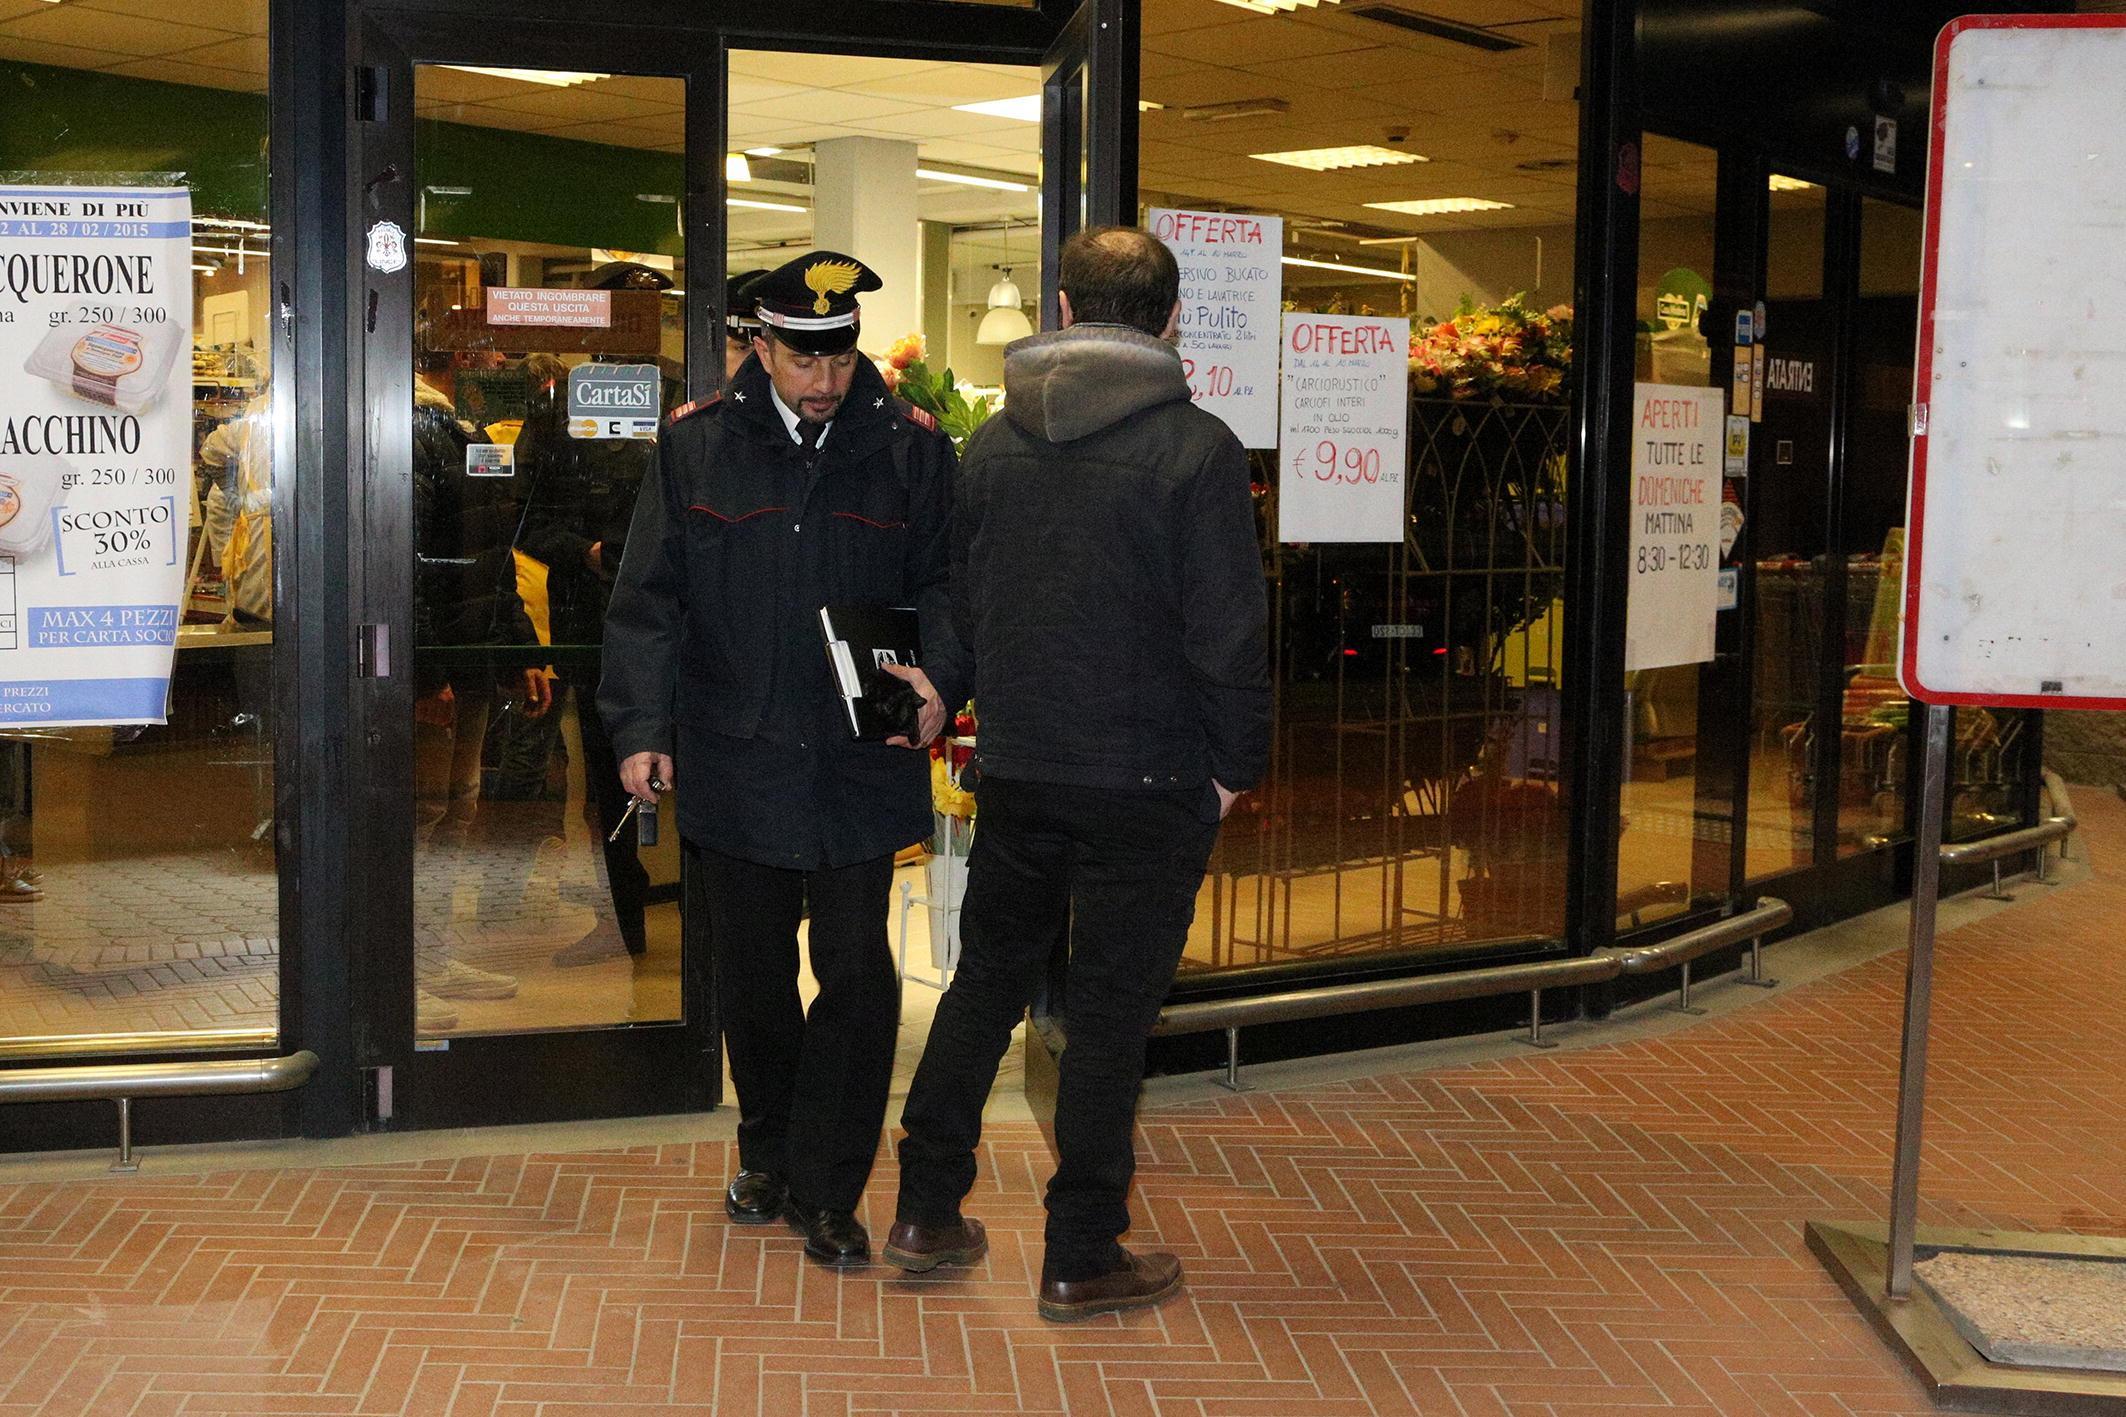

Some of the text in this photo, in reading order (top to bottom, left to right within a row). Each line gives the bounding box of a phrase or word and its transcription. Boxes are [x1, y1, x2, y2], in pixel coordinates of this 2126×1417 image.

[82, 203, 104, 217] DI
[116, 200, 149, 218] PIÙ
[18, 223, 43, 236] AL
[1156, 213, 1263, 244] OFFERTA
[1179, 267, 1269, 283] ERSIVO BUCATO
[492, 290, 607, 302] VIETATO INGOMBRARE
[1178, 288, 1256, 302] NO E LAVATRICE
[0, 309, 15, 323] a
[48, 310, 72, 328] gr.
[79, 306, 113, 324] 250
[133, 306, 167, 324] 300
[508, 303, 590, 313] QUESTA USCITA
[1177, 306, 1248, 329] iù Pulito
[492, 314, 606, 324] ANCHE TEMPORANEAMENTE
[1235, 330, 1243, 340] 2
[1292, 323, 1395, 355] OFFERTA
[1294, 396, 1366, 409] CARCIOFI INTERI
[1313, 414, 1323, 422] IN
[1641, 400, 1699, 429] APERTI
[0, 415, 141, 456] ACCHINO
[1646, 441, 1685, 465] TUTTE
[1690, 443, 1704, 465] LE
[1293, 448, 1307, 478] €
[1315, 441, 1380, 485] 9,90
[61, 473, 84, 490] gr.
[91, 469, 126, 485] 250
[144, 468, 175, 485] 300
[1638, 476, 1704, 506] DOMENICHE
[62, 506, 169, 533] SCONTO
[1645, 512, 1693, 534] MATTINA
[94, 529, 151, 555] 30%
[91, 556, 150, 570] ALLA CASSA
[42, 609, 174, 628] MAX 4 PEZZI
[39, 629, 175, 645] PER CARTA SOCIO
[4, 687, 49, 697] PREZZI
